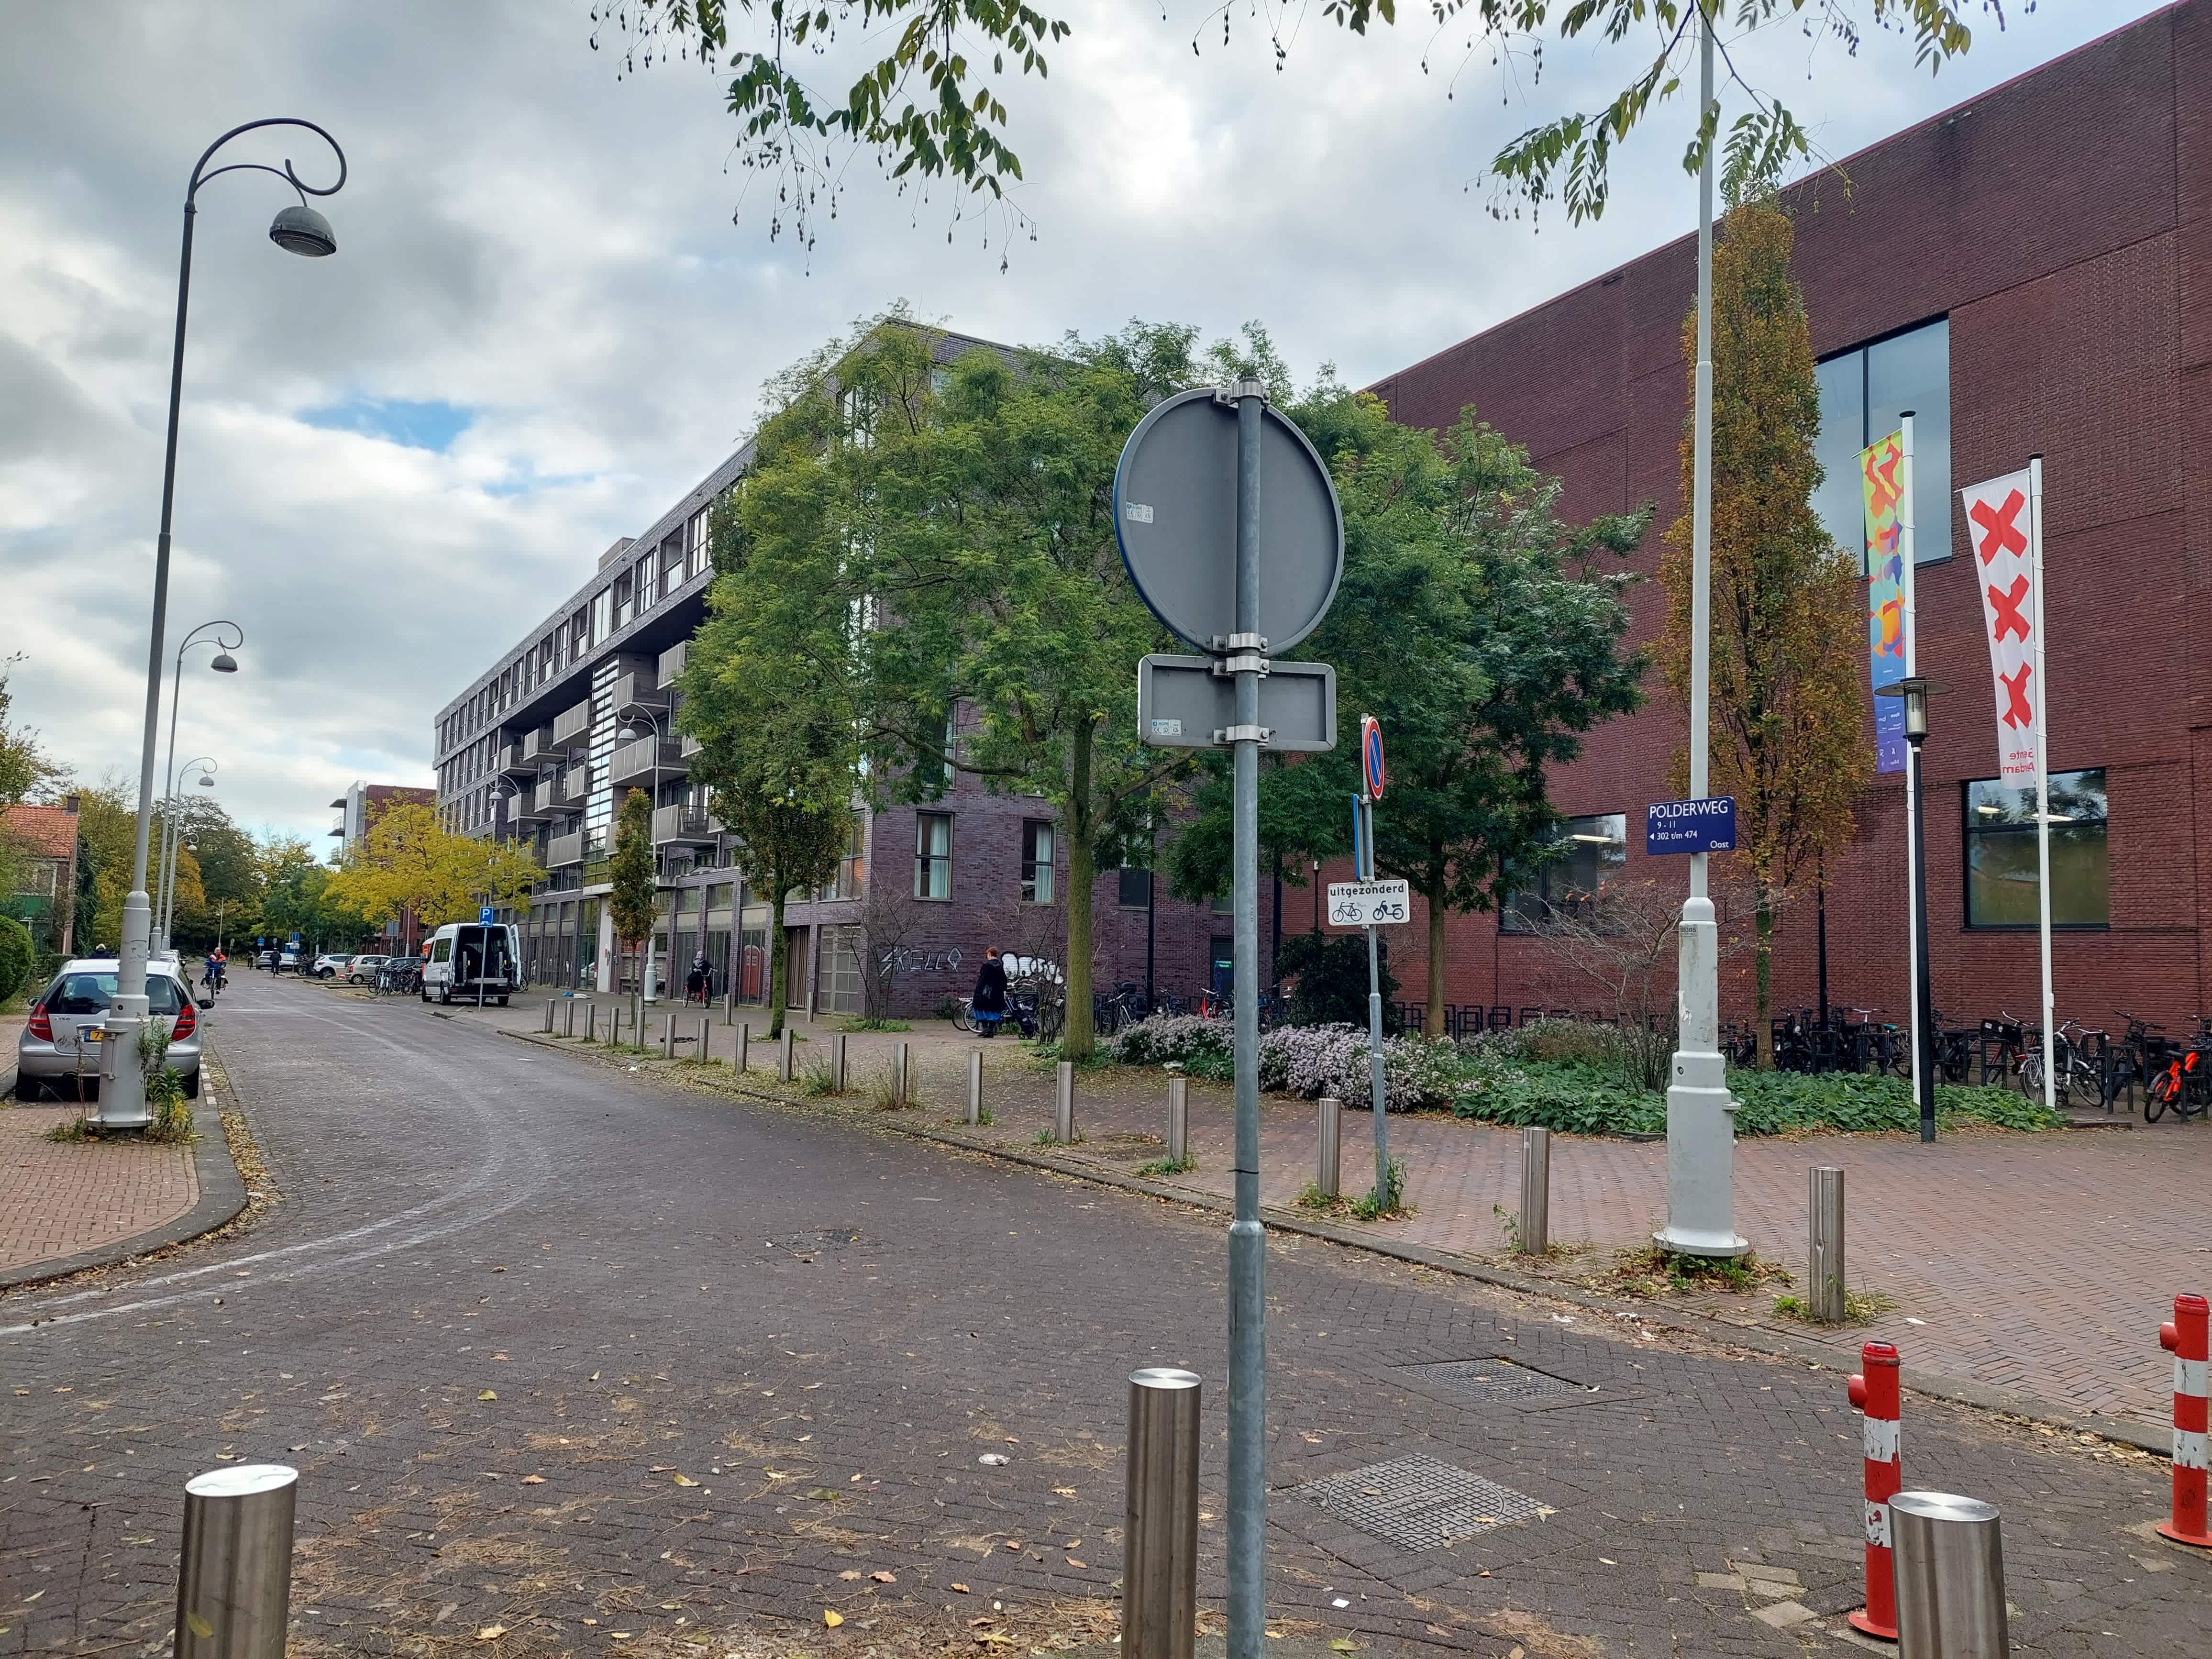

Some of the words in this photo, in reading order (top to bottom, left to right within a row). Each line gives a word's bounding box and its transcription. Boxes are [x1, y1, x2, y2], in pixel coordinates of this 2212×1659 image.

[1649, 800, 1728, 819] POLDERWEG
[1669, 820, 1676, 829] 11
[1657, 832, 1669, 841] 302
[1670, 831, 1683, 840] t/m
[1684, 830, 1698, 839] 474
[1710, 840, 1729, 849] Oost
[1330, 884, 1404, 898] uitgezonderd
[482, 908, 490, 919] P
